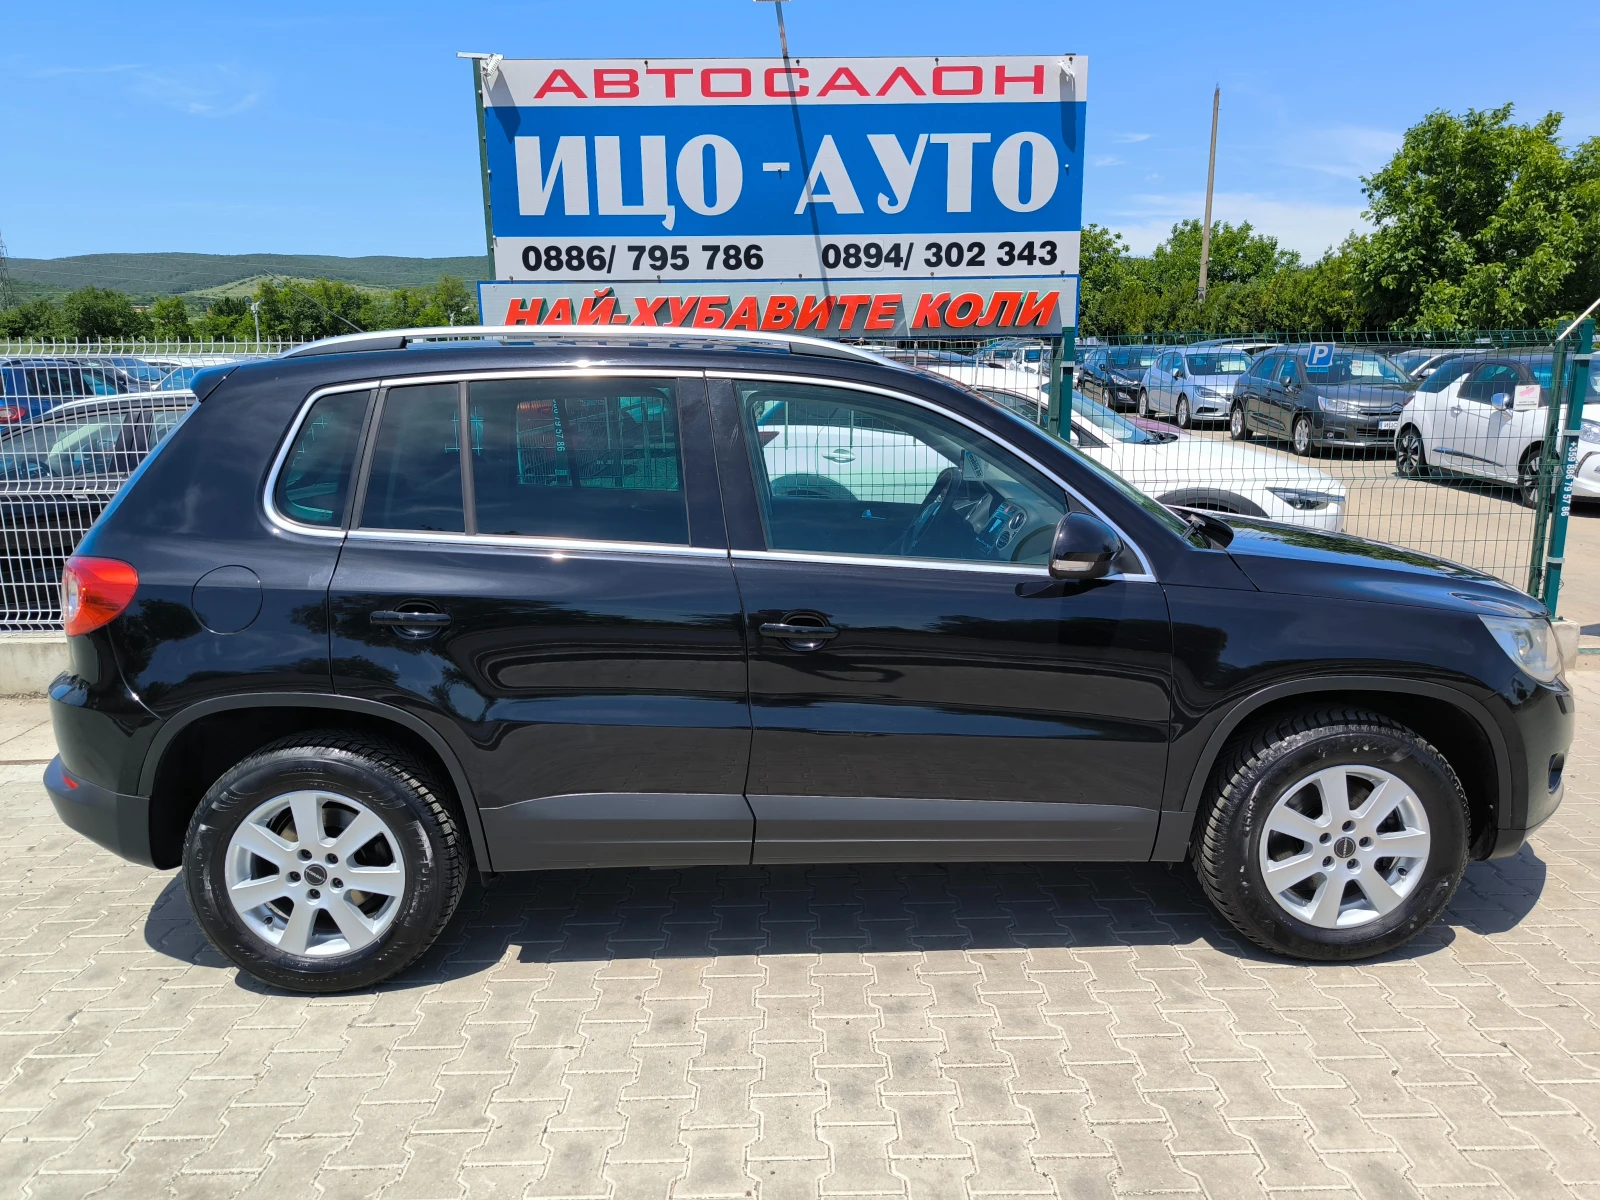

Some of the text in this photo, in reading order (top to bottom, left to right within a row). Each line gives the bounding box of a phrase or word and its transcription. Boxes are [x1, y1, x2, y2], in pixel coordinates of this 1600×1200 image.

[534, 64, 1045, 99] АВТОСАЛОН
[514, 134, 743, 231] ИЦО
[522, 244, 765, 274] 0886/ 795 786
[822, 240, 1058, 271] 0894/ 302 343
[504, 286, 1060, 331] НАЙ-ХУБАВИТЕ КОЛИ
[1312, 346, 1328, 364] P
[557, 442, 566, 452] 86
[1561, 441, 1578, 516] +359 886 79 57 86
